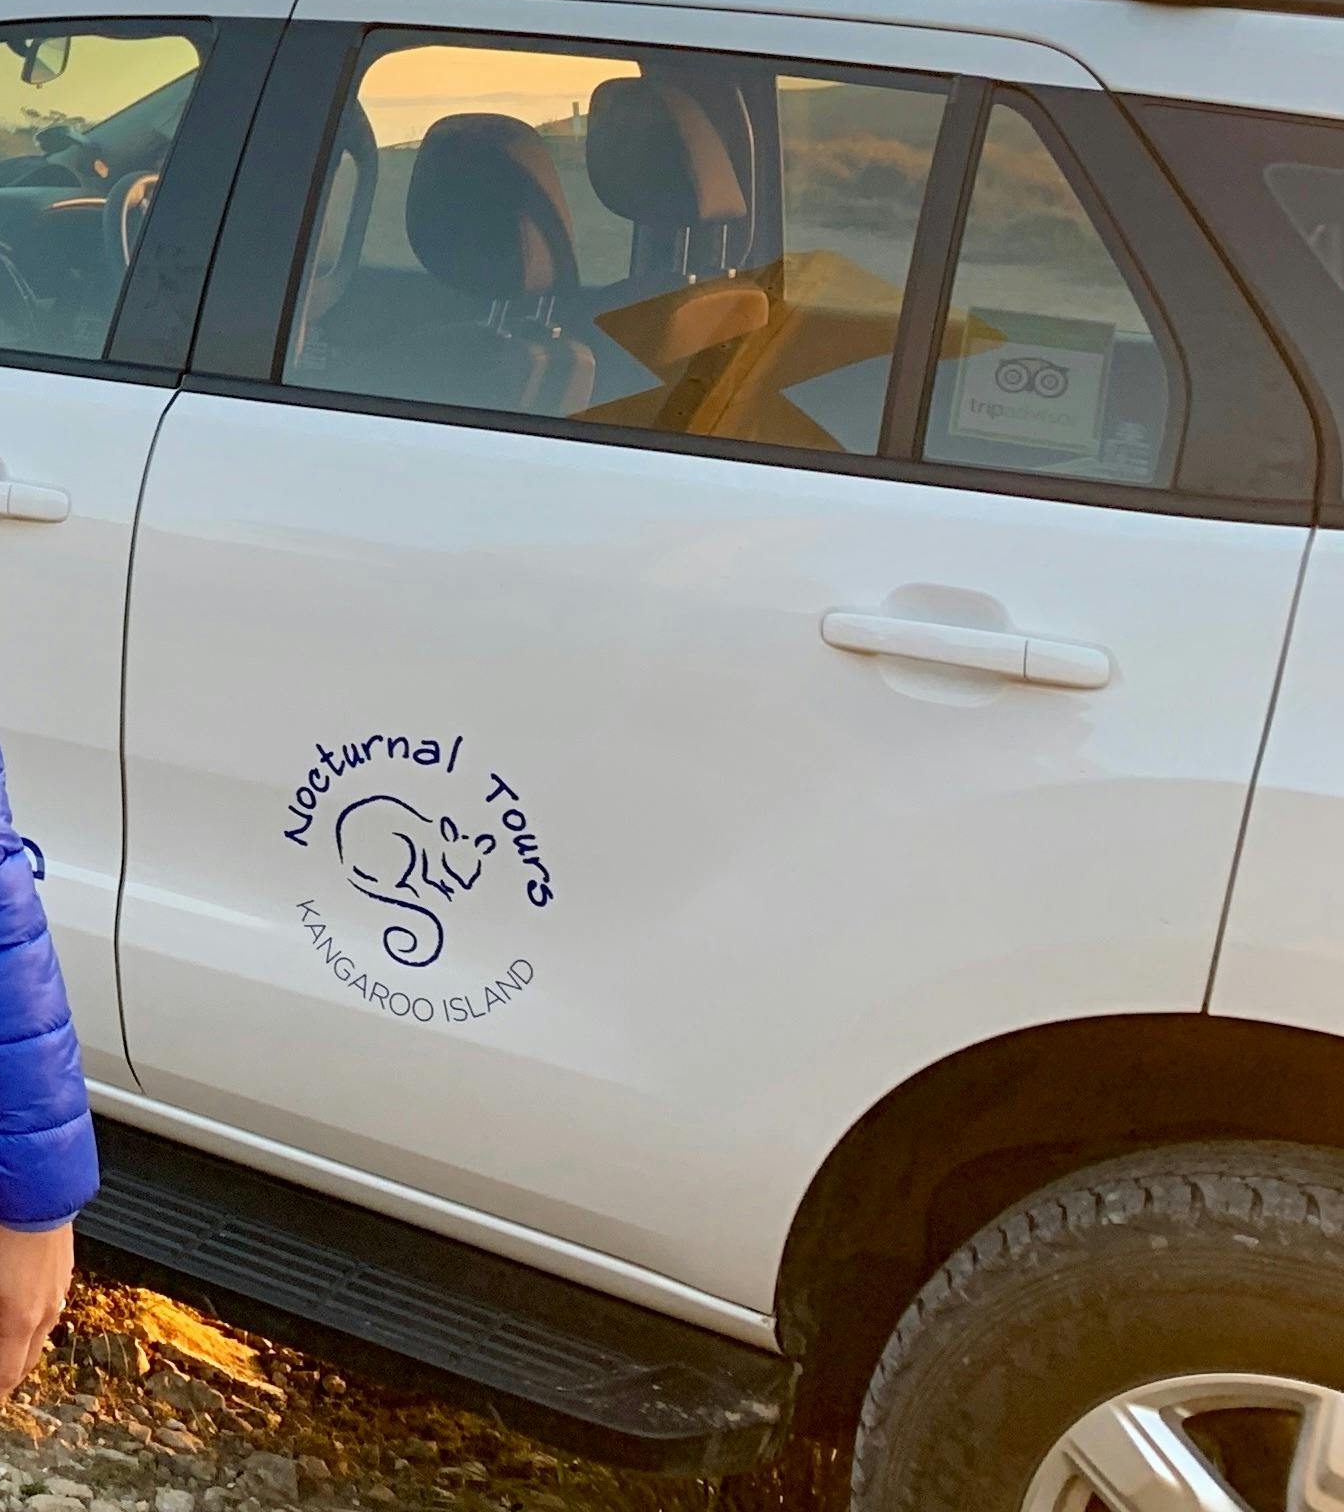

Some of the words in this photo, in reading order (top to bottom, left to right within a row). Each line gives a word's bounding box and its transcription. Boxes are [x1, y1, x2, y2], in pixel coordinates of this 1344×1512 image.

[283, 735, 464, 847] Nocturnal
[485, 773, 554, 908] Tours
[296, 899, 435, 1023] KANGAROO
[443, 958, 534, 1023] ISLAND
